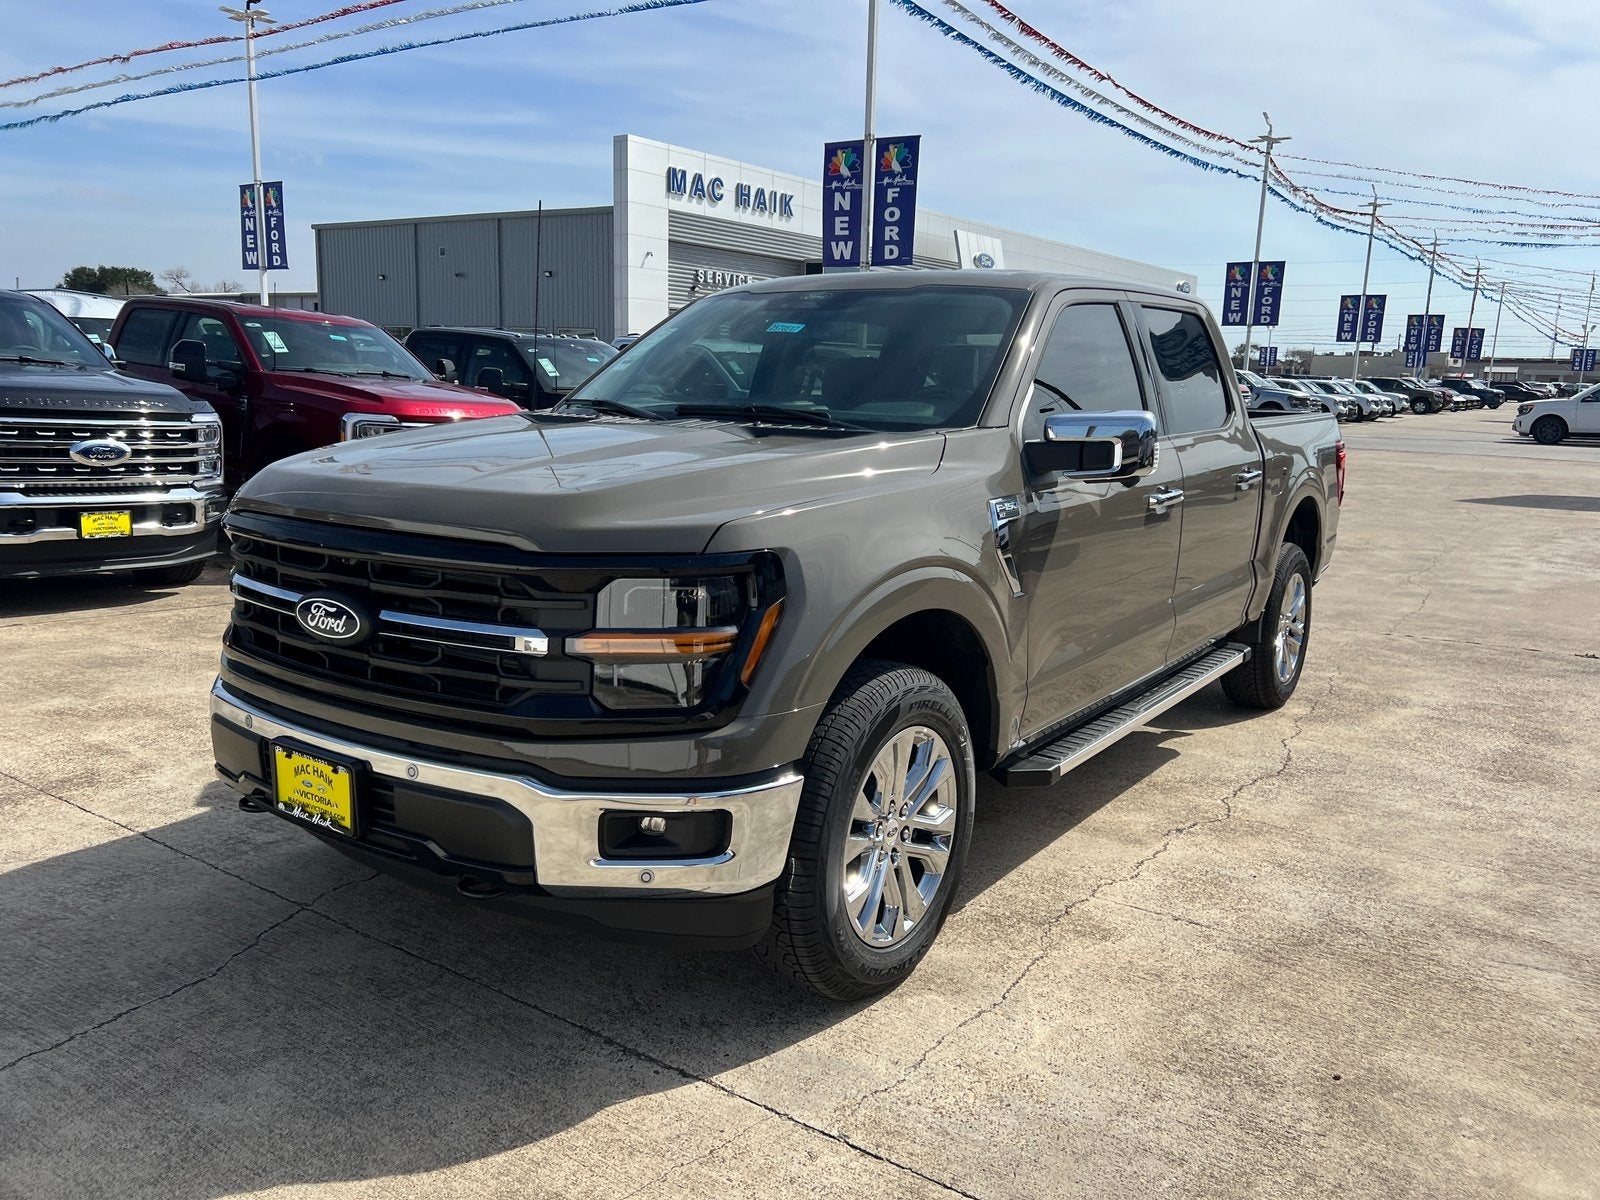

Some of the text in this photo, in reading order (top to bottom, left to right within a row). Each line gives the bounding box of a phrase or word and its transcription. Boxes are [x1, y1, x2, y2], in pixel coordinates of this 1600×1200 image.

[669, 167, 794, 217] MAC HAIK
[831, 191, 853, 260] NEW
[884, 187, 901, 260] FORD
[245, 218, 257, 265] NEW
[270, 217, 281, 266] FORD
[698, 269, 753, 286] SERVICE
[1228, 287, 1241, 323] NEW
[1260, 287, 1273, 324] FORD
[1341, 313, 1353, 340] NEW
[1367, 313, 1377, 341] FORD
[1408, 329, 1418, 350] NEW
[1429, 329, 1437, 351] FORD
[1453, 340, 1463, 357] NEW
[92, 515, 104, 523] MAC
[307, 602, 347, 633] Ford
[909, 700, 955, 721] PIRELLI
[294, 764, 311, 777] MAC
[312, 767, 334, 789] HAIK
[298, 789, 332, 808] VICTORIA
[292, 806, 333, 827] Mac Haik
